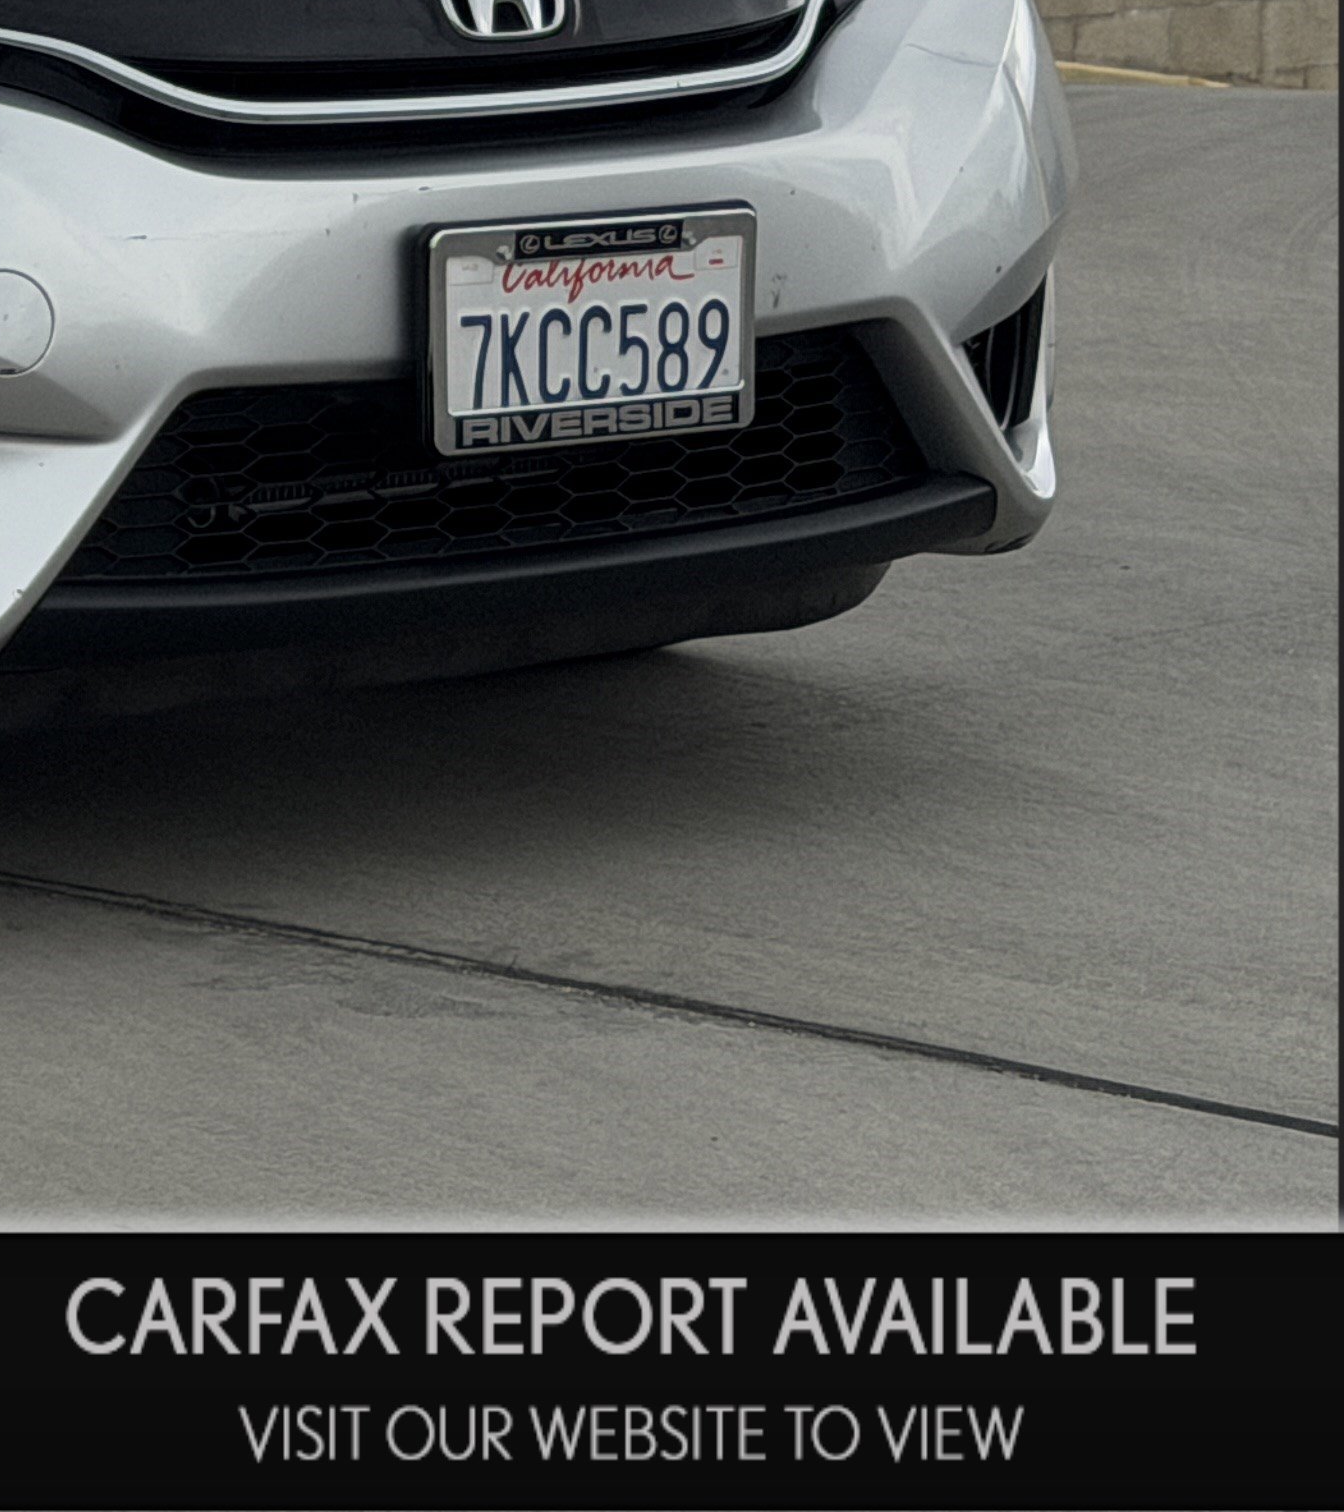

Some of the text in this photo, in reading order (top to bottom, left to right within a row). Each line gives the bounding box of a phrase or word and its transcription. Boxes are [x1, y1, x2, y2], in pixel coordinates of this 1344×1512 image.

[544, 231, 656, 251] LEXUS
[501, 254, 695, 304] California
[460, 298, 730, 410] 7KCC589
[462, 394, 735, 447] RIVERSIDE
